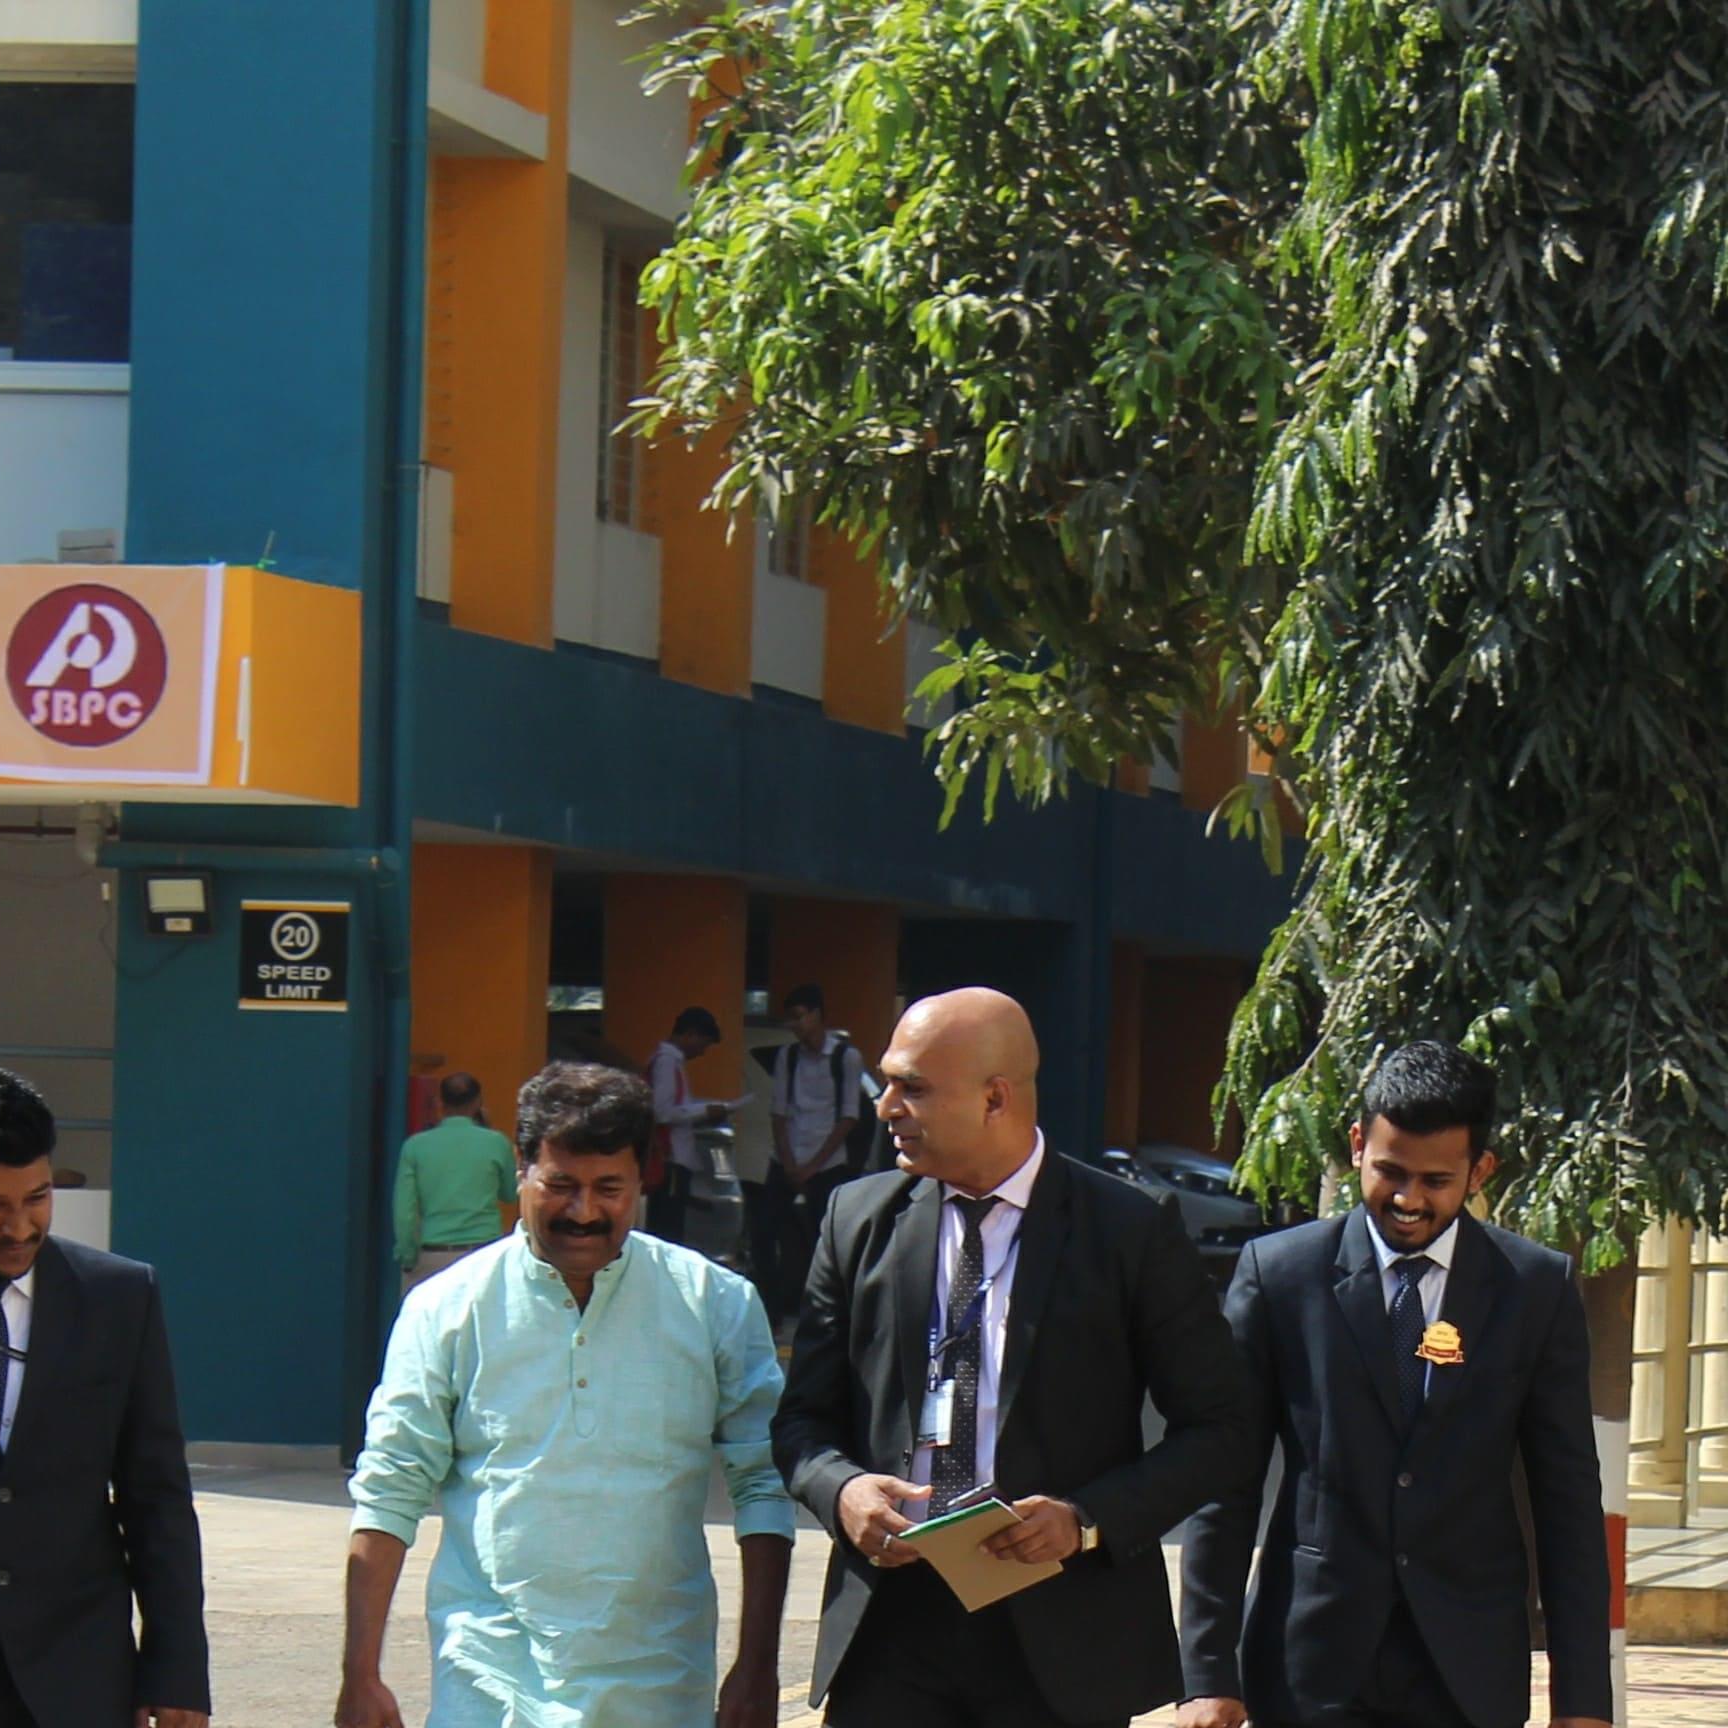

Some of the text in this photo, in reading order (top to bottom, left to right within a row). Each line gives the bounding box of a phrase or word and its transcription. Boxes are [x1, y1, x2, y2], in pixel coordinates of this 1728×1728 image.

[29, 689, 144, 729] SBPC
[280, 926, 310, 947] 20
[258, 965, 331, 981] SPEED
[266, 984, 322, 999] LIMIT
